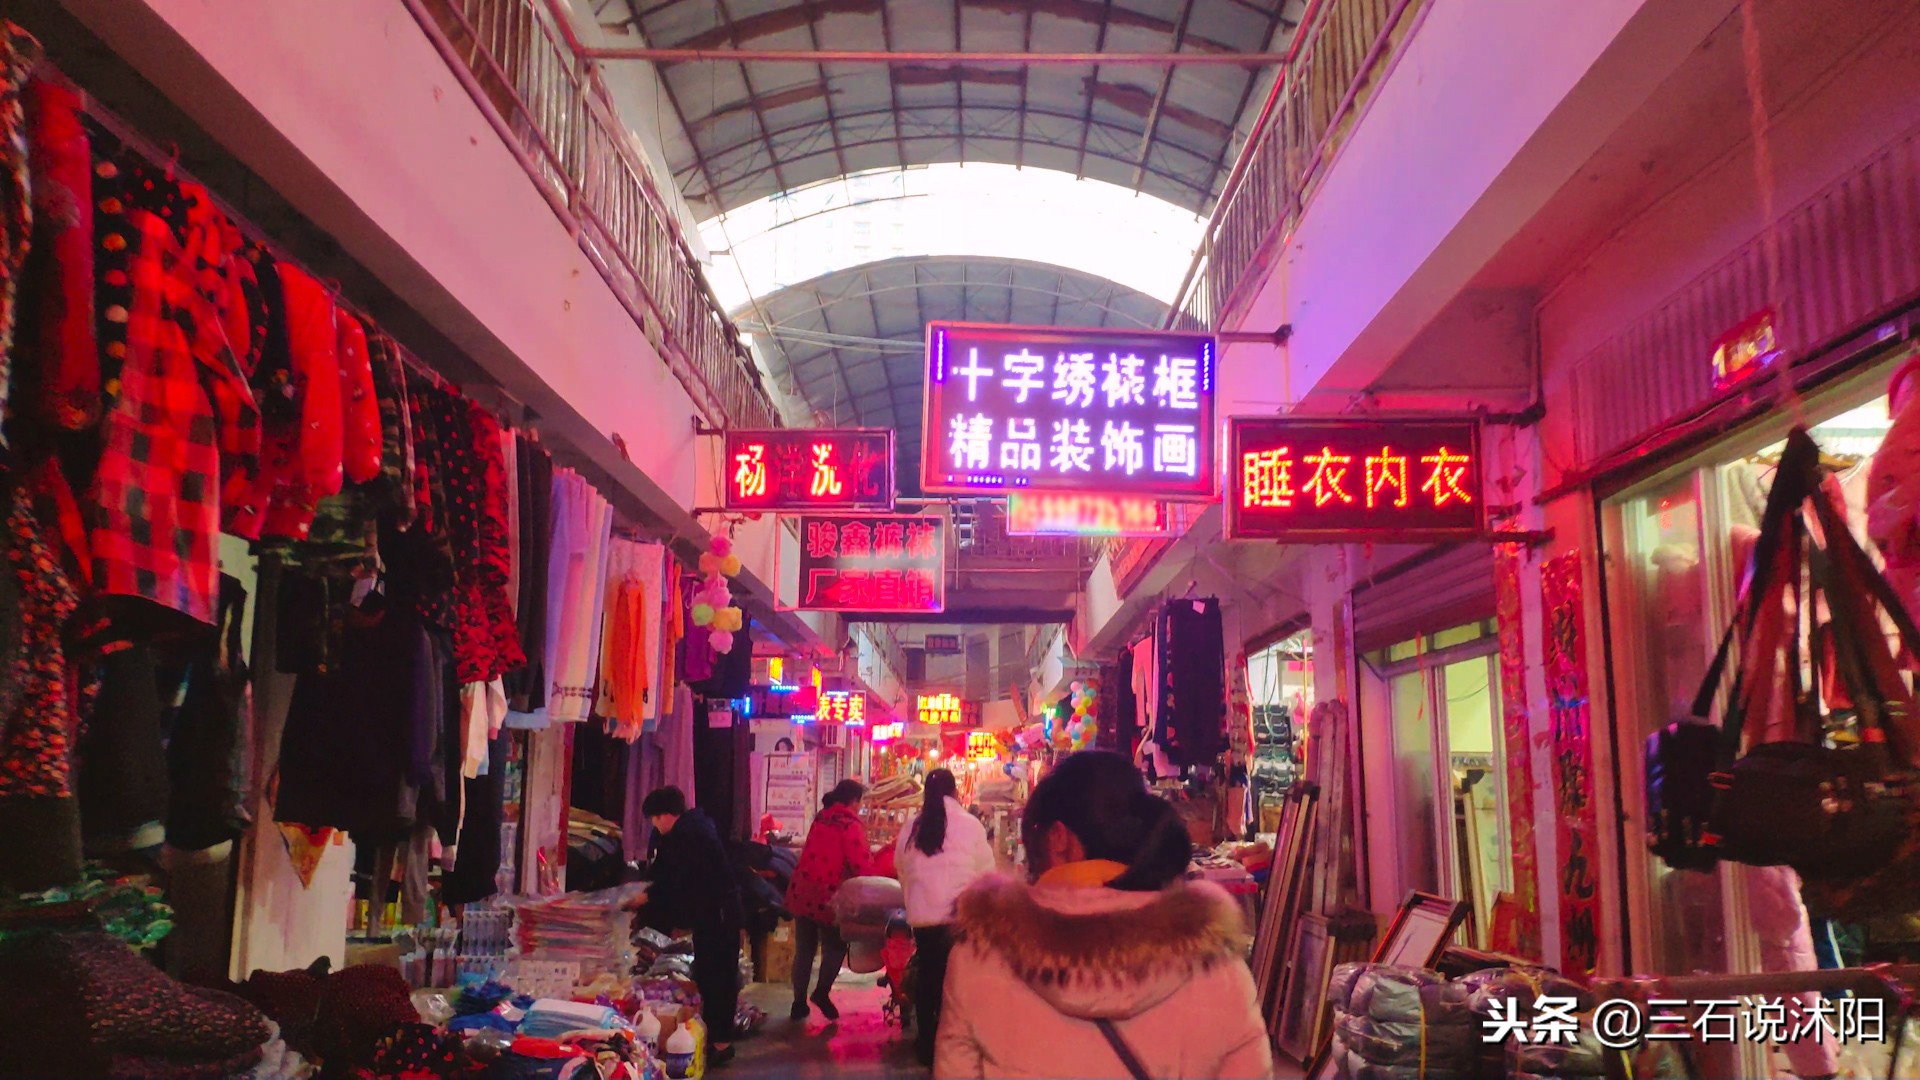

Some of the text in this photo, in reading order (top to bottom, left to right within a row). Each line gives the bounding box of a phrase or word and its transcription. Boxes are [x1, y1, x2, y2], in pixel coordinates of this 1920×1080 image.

[951, 347, 1199, 409] 十字绣裱框
[735, 440, 884, 498] 杨洋洗化
[949, 412, 1196, 476] 精品装饰画
[1243, 446, 1472, 508] 睡衣内衣
[807, 520, 937, 559] 骏鑫裤袜
[805, 567, 936, 605] 厂家直销
